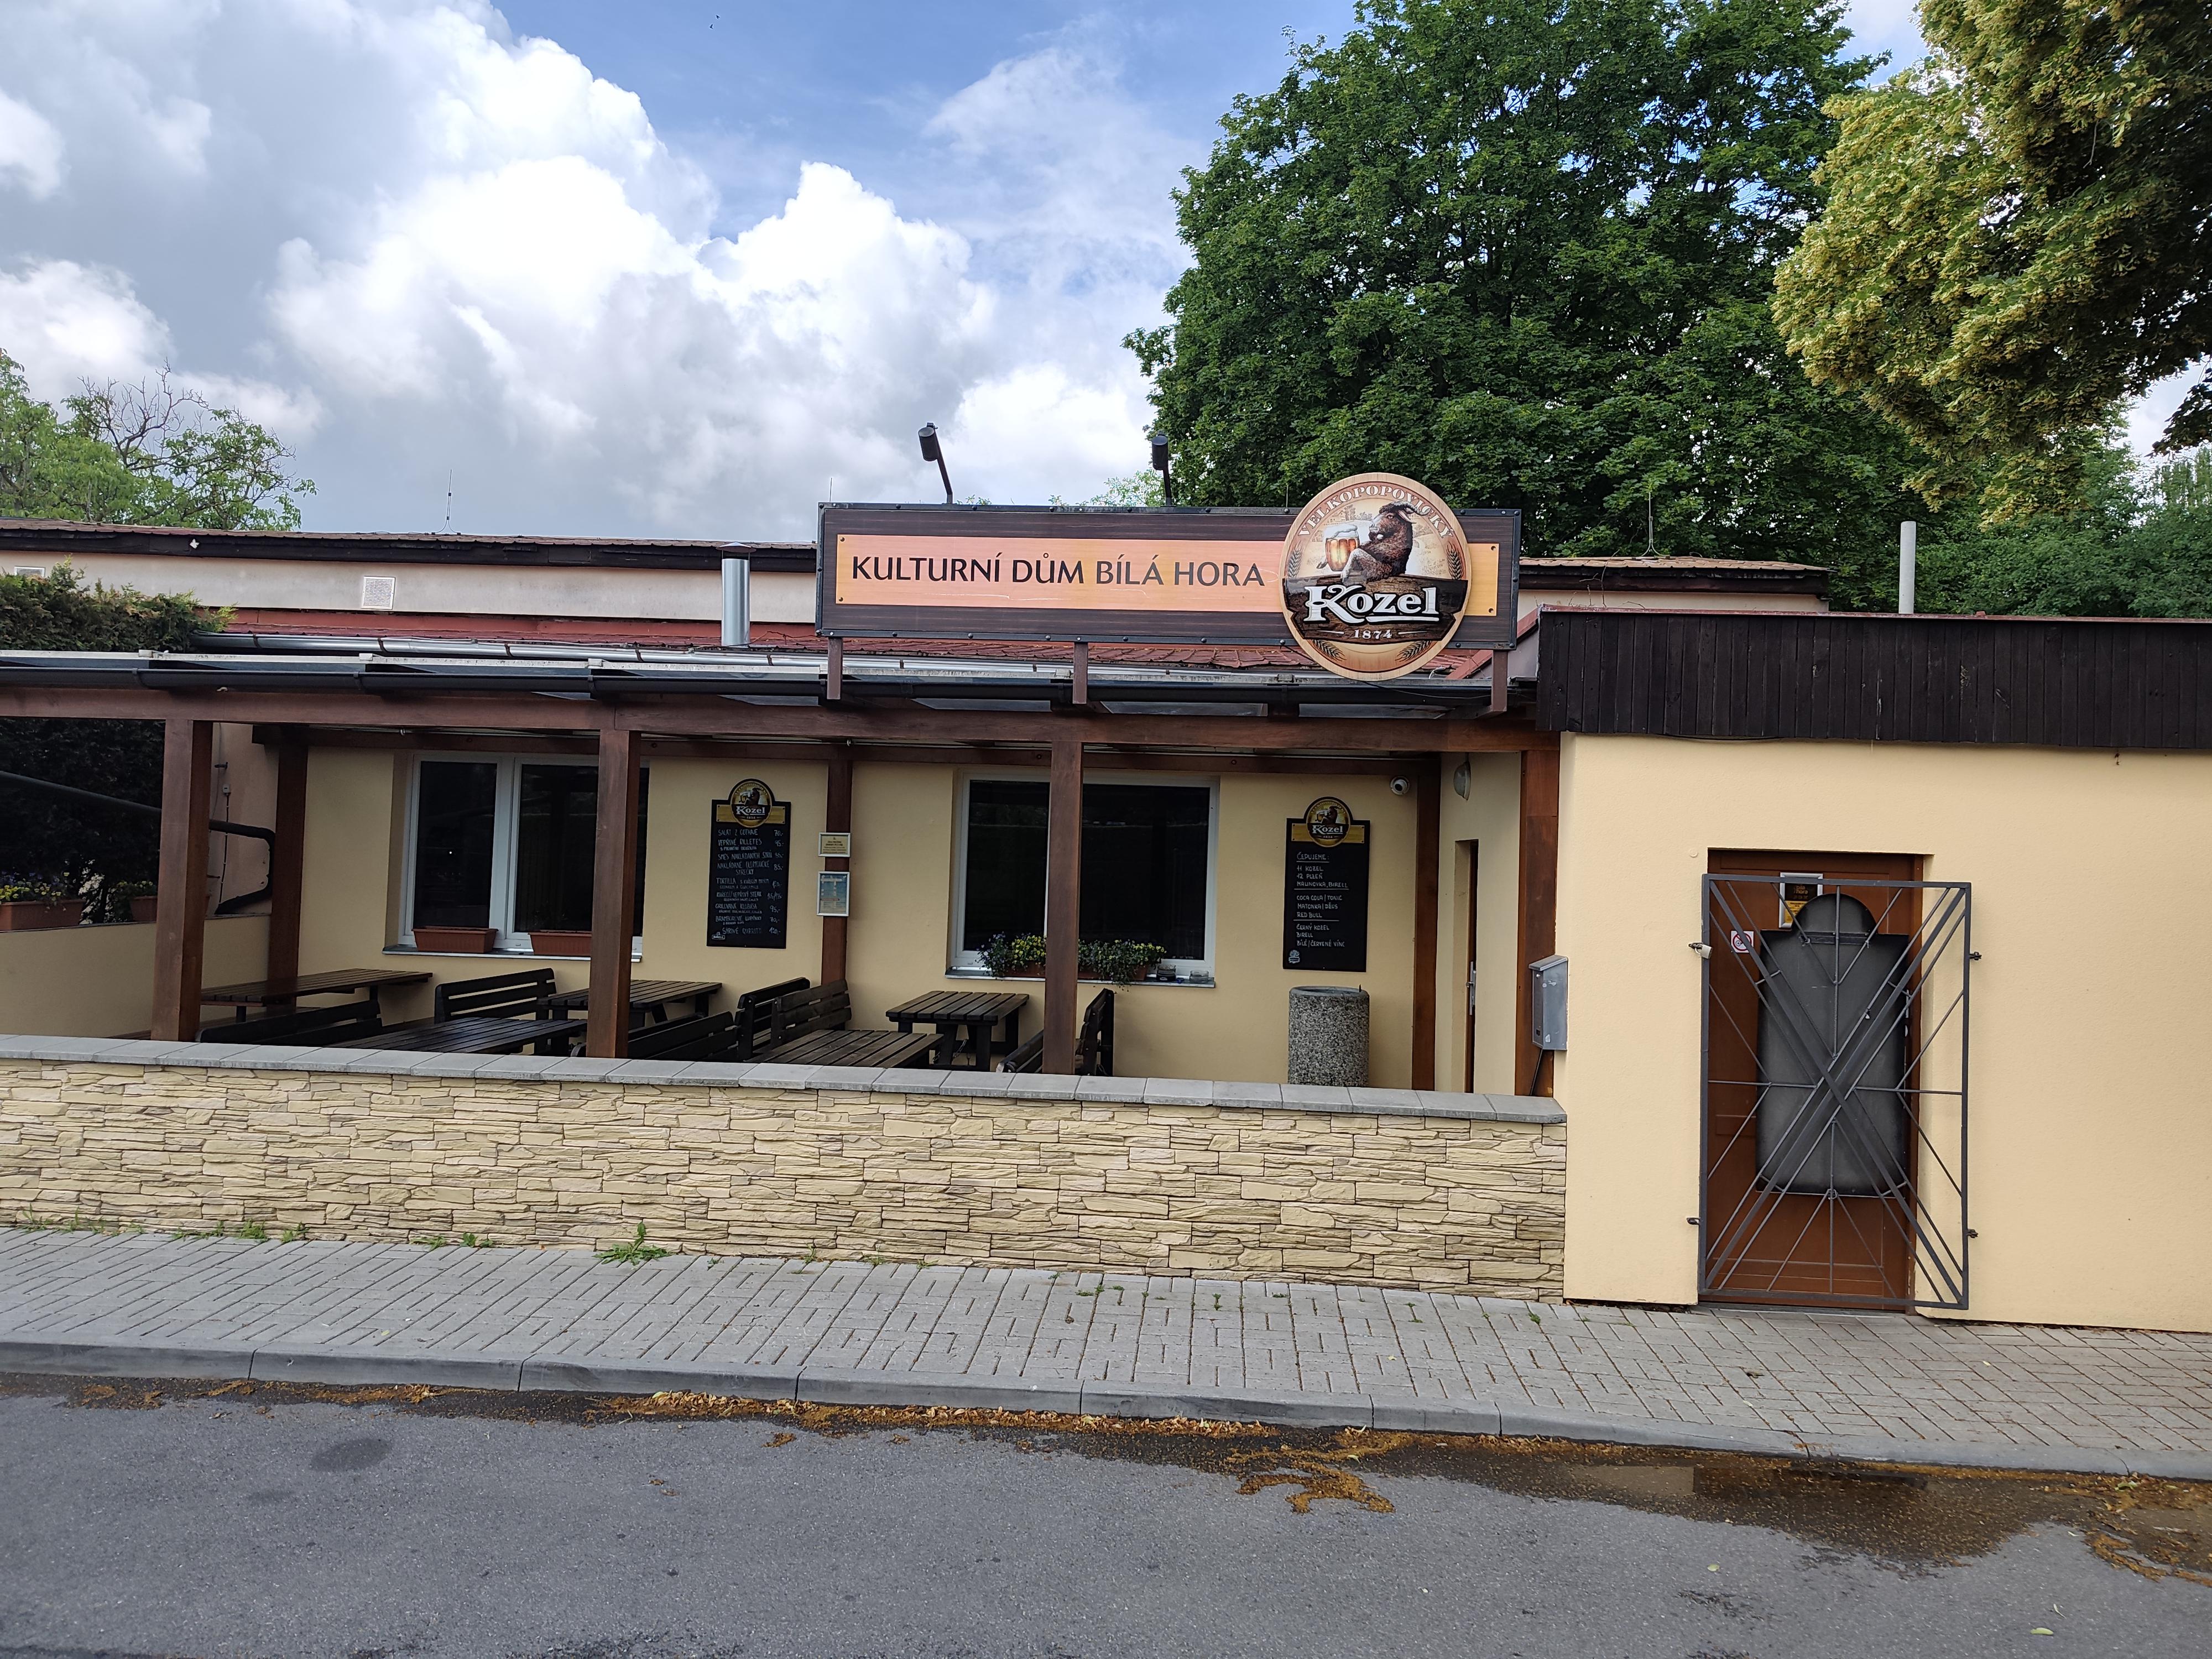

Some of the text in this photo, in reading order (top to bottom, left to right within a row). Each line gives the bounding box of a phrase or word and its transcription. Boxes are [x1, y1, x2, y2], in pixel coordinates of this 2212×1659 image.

[1298, 484, 1454, 539] VELKOPOPOVICKÝ
[852, 550, 1265, 586] KULTURNÍ DŮM BÍLÁ HORA
[1303, 585, 1439, 623] Kozel
[1353, 629, 1392, 639] 1874
[735, 806, 766, 816] Kozel
[1311, 825, 1344, 835] Kozel
[1296, 922, 1312, 931] ČERNÝ
